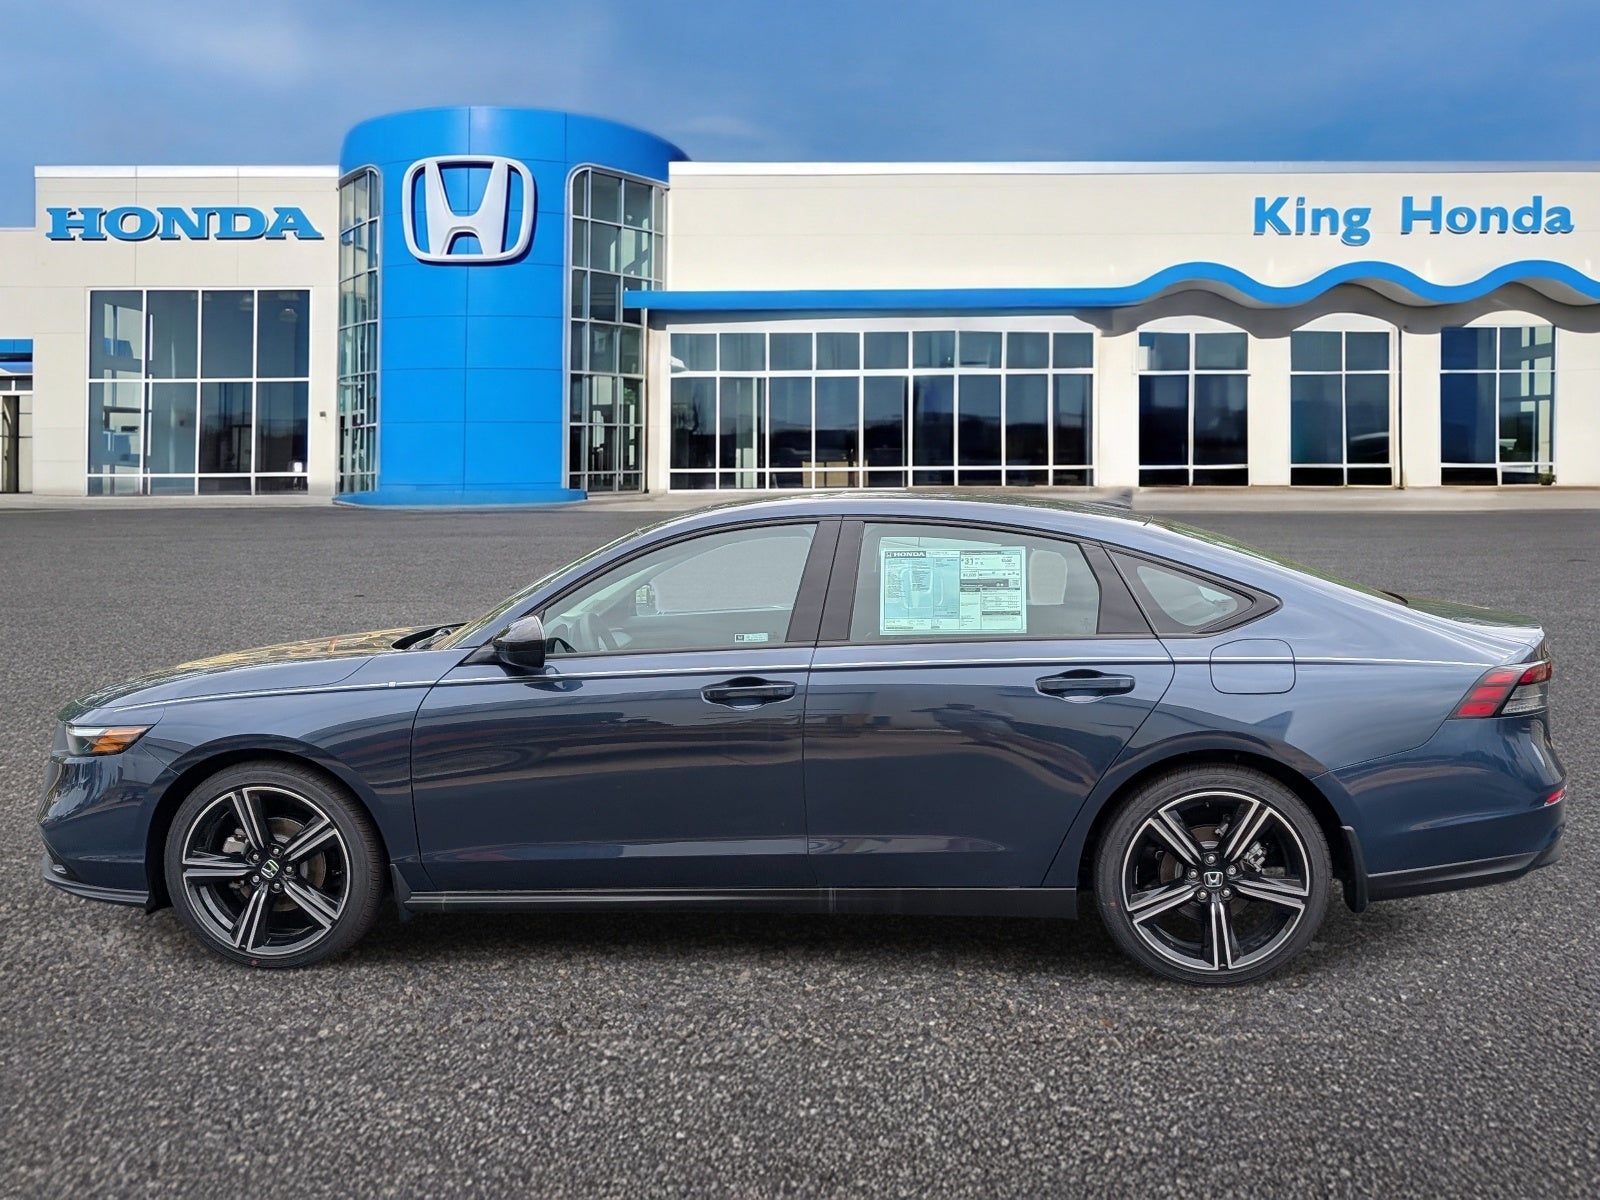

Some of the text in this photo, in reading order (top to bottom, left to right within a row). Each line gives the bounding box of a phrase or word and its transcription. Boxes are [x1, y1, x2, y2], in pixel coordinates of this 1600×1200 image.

[45, 206, 325, 241] HONDA
[1254, 195, 1575, 246] King Honda
